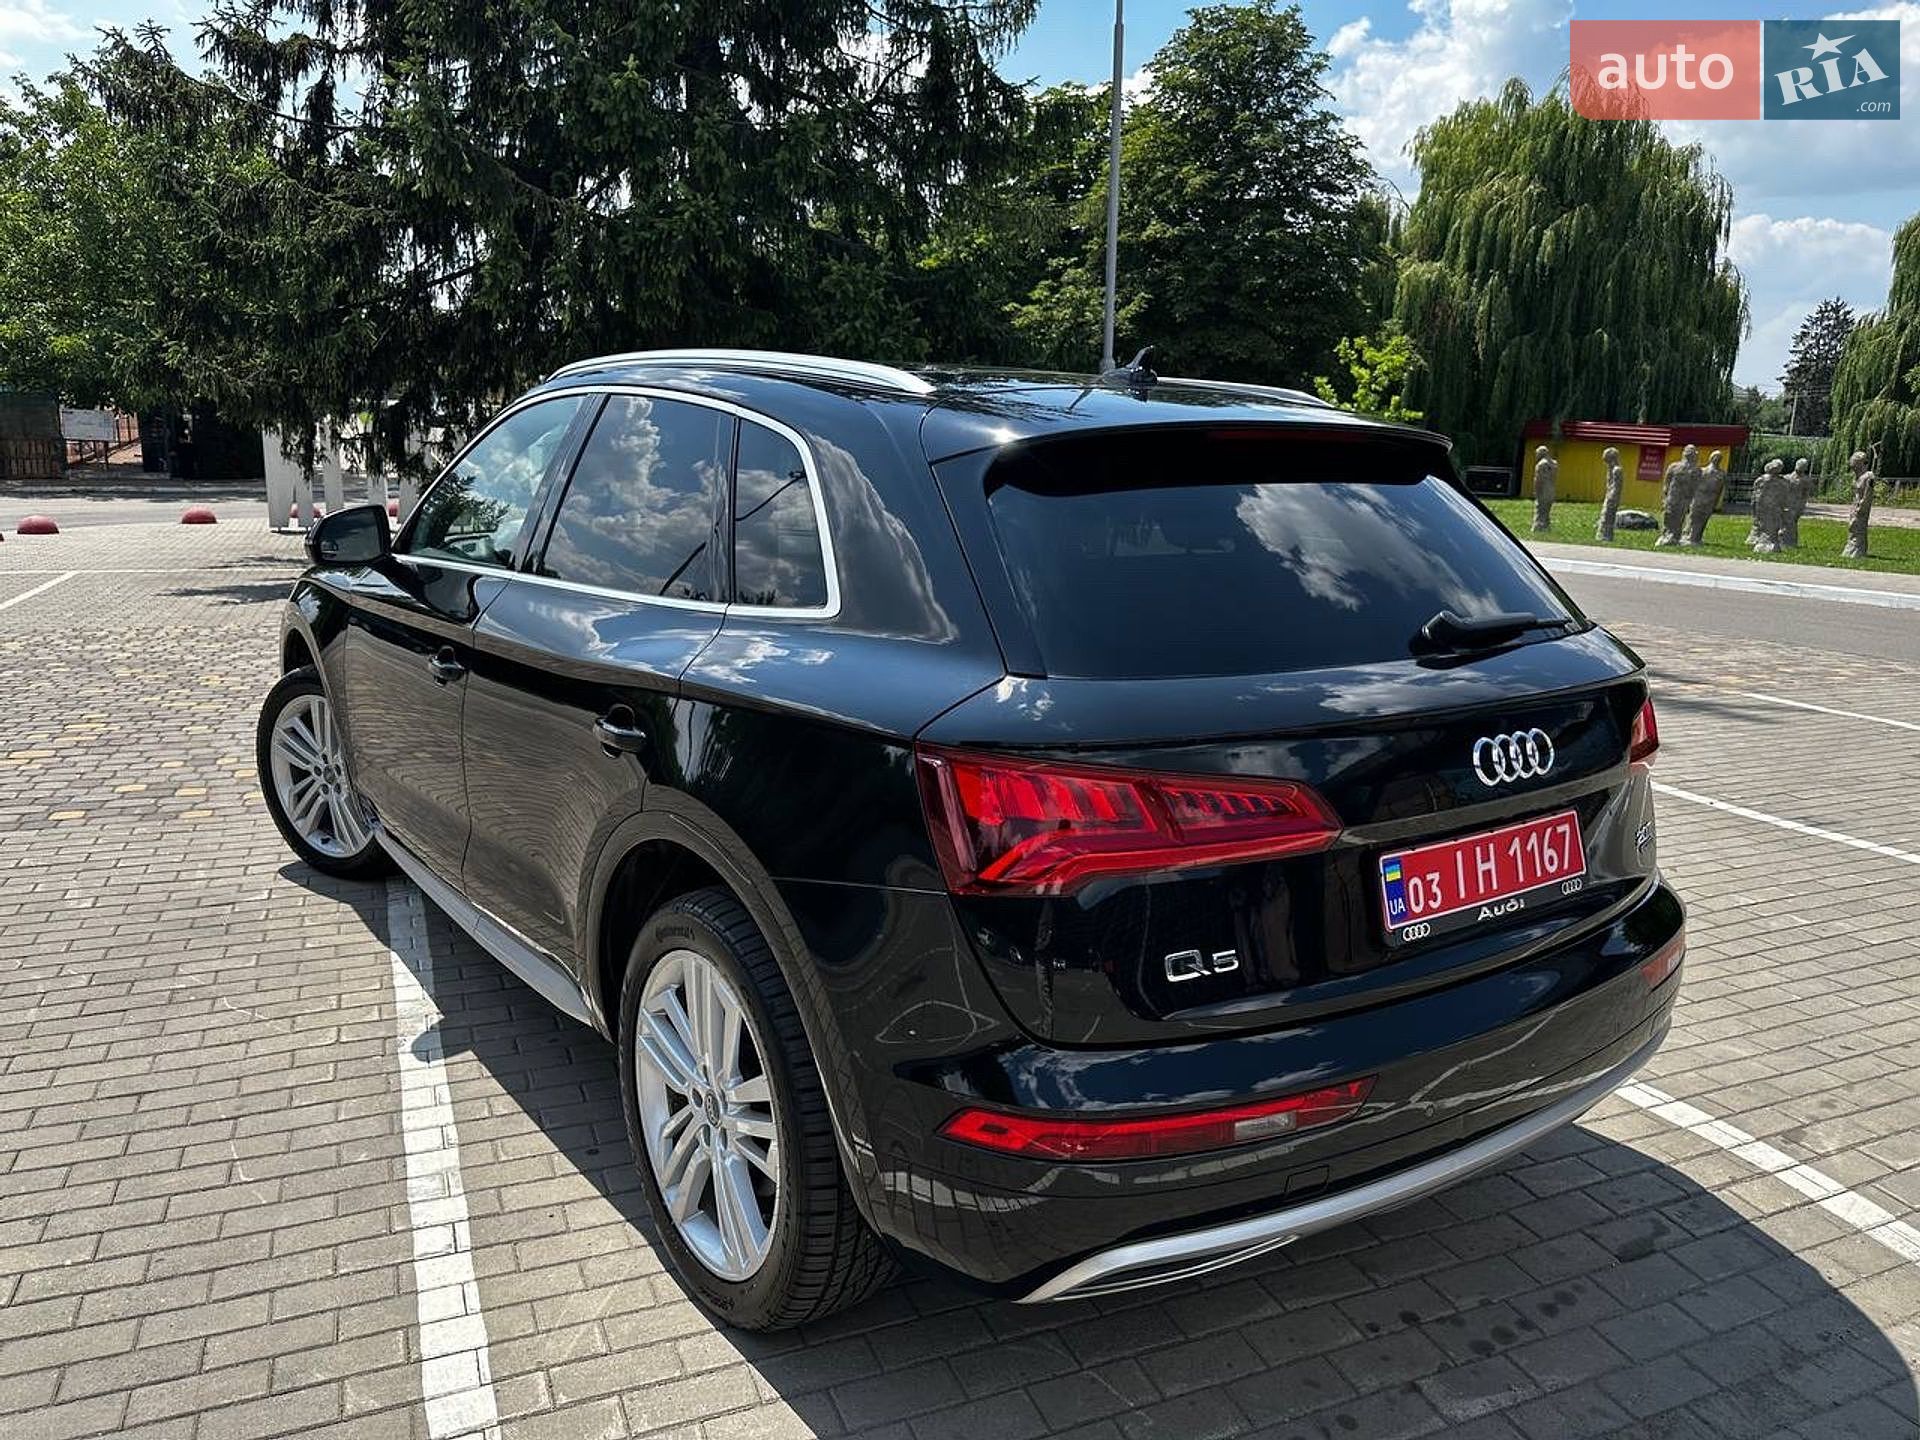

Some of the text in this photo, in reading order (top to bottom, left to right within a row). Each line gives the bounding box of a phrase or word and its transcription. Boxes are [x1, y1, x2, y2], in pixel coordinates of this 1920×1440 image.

[1389, 900, 1407, 915] UA
[1408, 872, 1442, 913] 03
[1507, 823, 1570, 883] 1167
[1477, 898, 1525, 921] Audi
[1164, 949, 1239, 982] Q5
